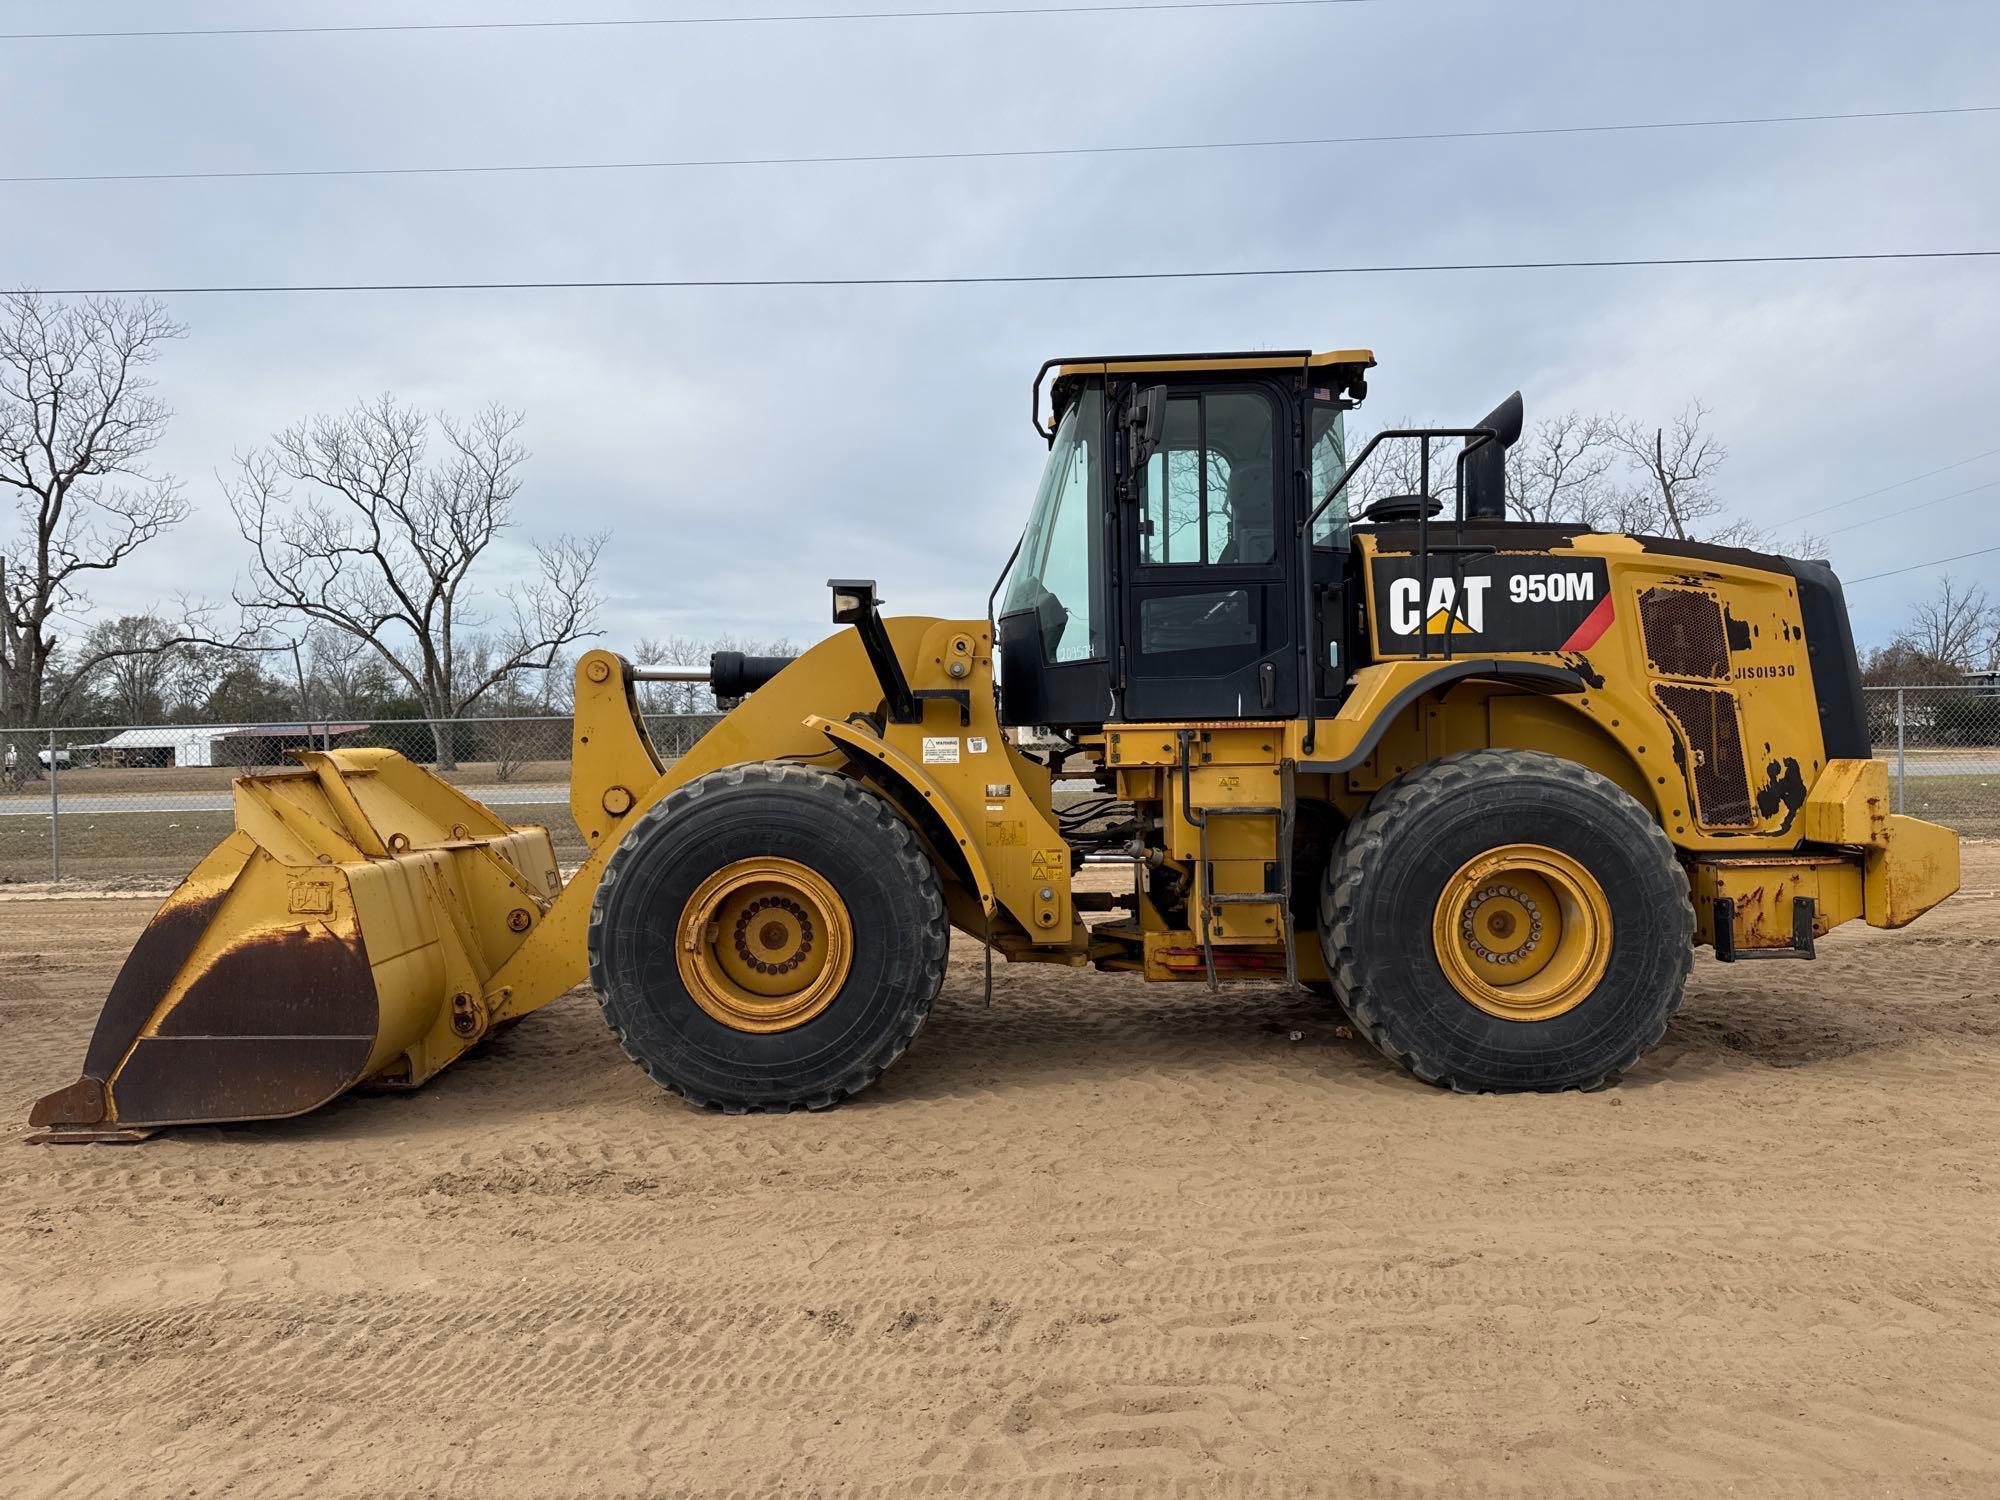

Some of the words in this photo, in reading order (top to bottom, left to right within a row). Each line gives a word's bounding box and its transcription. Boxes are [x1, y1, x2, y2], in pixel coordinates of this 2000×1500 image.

[1509, 572, 1594, 603] 950M
[1390, 576, 1491, 635] CAT
[292, 887, 330, 909] CAT
